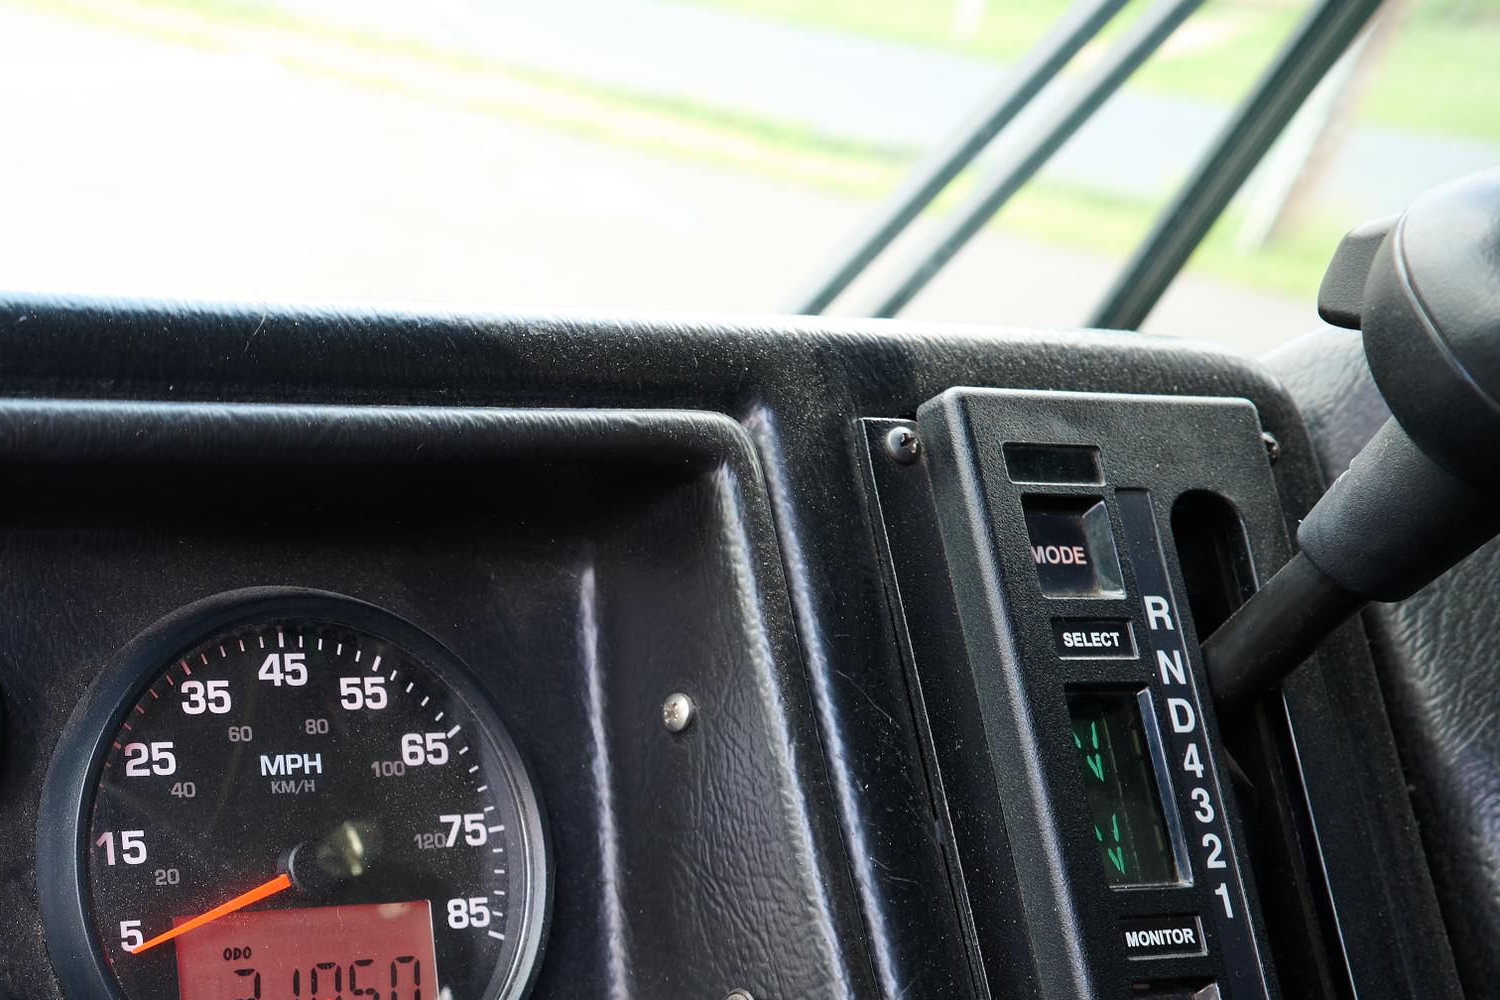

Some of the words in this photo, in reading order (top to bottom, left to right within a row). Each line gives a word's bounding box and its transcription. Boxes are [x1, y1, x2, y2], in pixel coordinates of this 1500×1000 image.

[1031, 545, 1087, 565] MODE
[1144, 595, 1175, 631] R
[1062, 632, 1120, 647] SELECT
[258, 652, 309, 687] 45
[1156, 650, 1187, 685] N
[180, 679, 232, 715] 35
[339, 676, 388, 710] 55
[305, 718, 329, 735] 80
[1167, 698, 1195, 733] D
[228, 726, 253, 742] 60
[401, 732, 449, 766] 65
[124, 741, 177, 777] 25
[260, 753, 323, 776] MPH
[372, 760, 405, 778] 100
[1183, 744, 1204, 778] 4
[170, 782, 196, 798] 40
[271, 779, 316, 795] KM/H
[1192, 787, 1215, 824] 3
[413, 833, 447, 850] 120
[439, 813, 488, 848] 75
[96, 830, 147, 866] 15
[1202, 833, 1226, 869] 2
[155, 869, 180, 886] 20
[447, 897, 490, 930] 85
[1214, 883, 1234, 918] 1
[119, 920, 144, 952] 5
[1125, 927, 1196, 948] MONITOR
[223, 946, 252, 961] ODO
